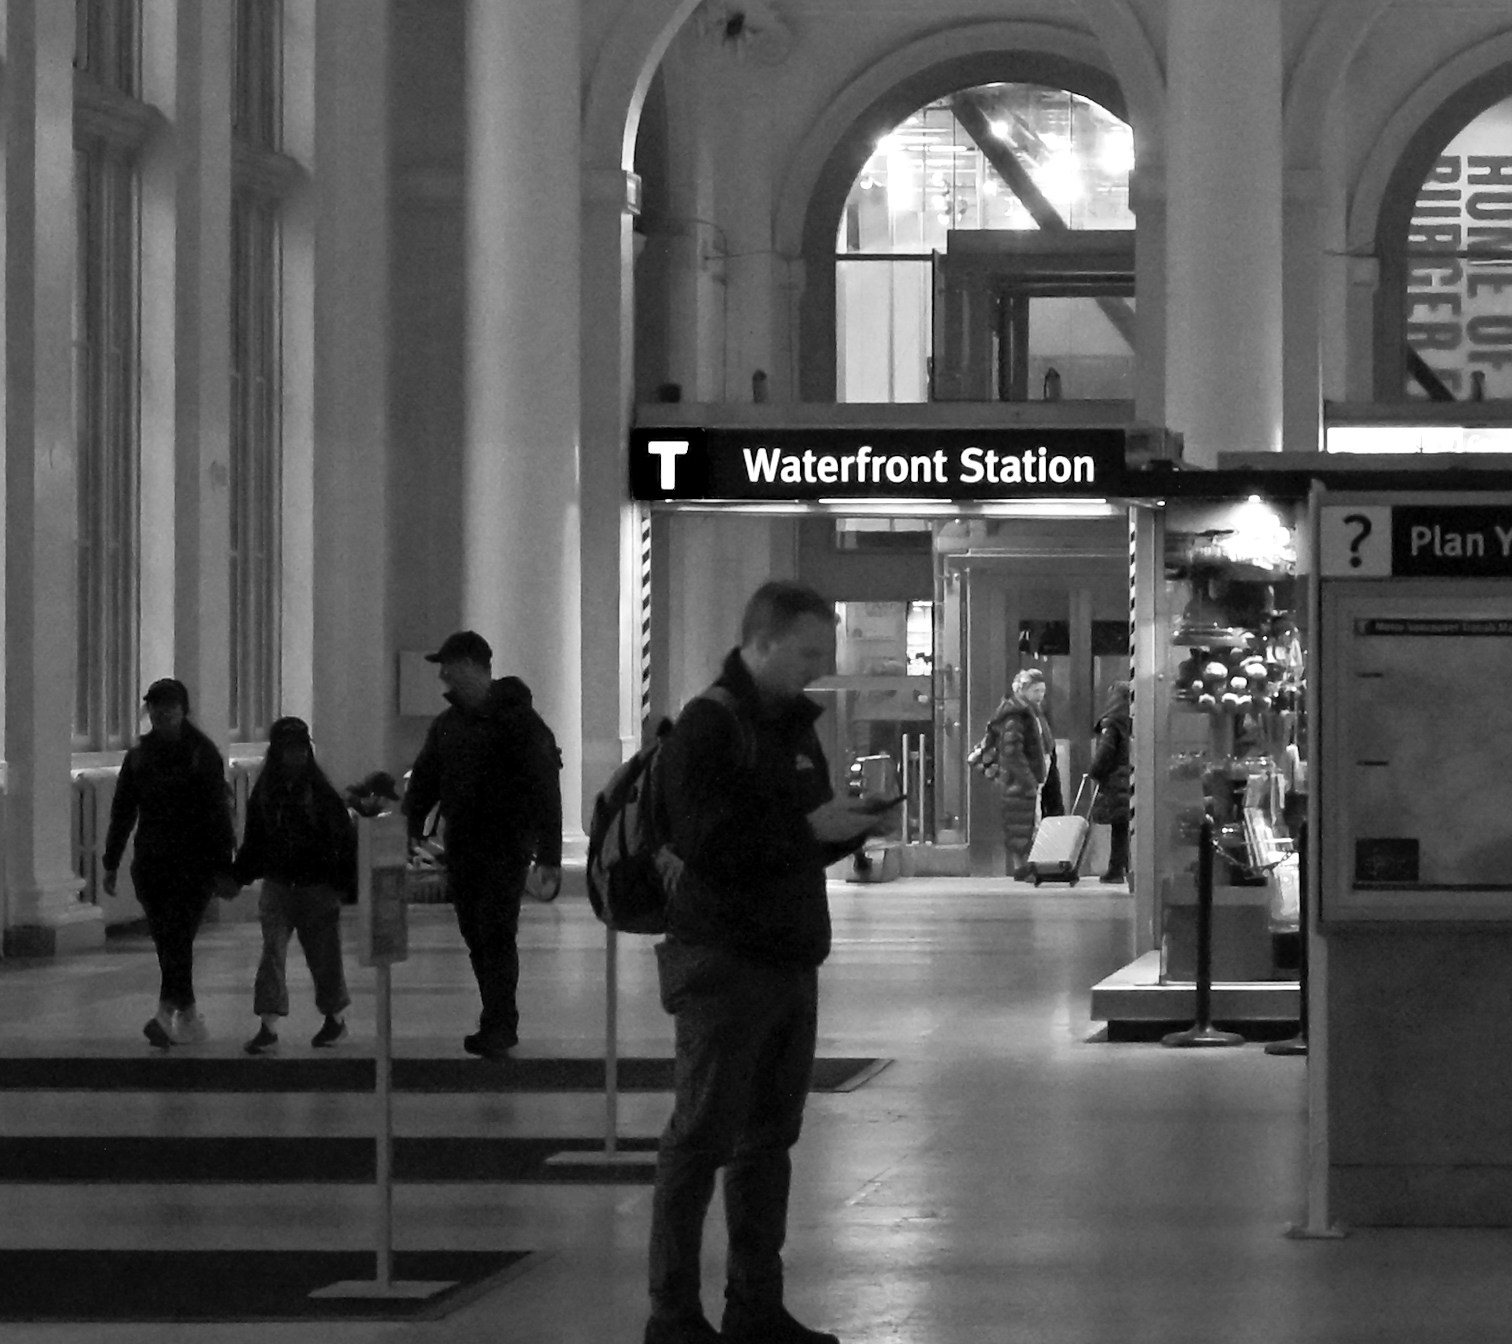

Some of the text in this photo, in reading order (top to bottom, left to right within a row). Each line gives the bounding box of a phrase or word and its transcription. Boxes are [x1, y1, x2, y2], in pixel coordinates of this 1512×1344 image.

[647, 440, 690, 491] T
[742, 445, 1095, 484] Waterfront Station
[1410, 526, 1485, 557] Plan
